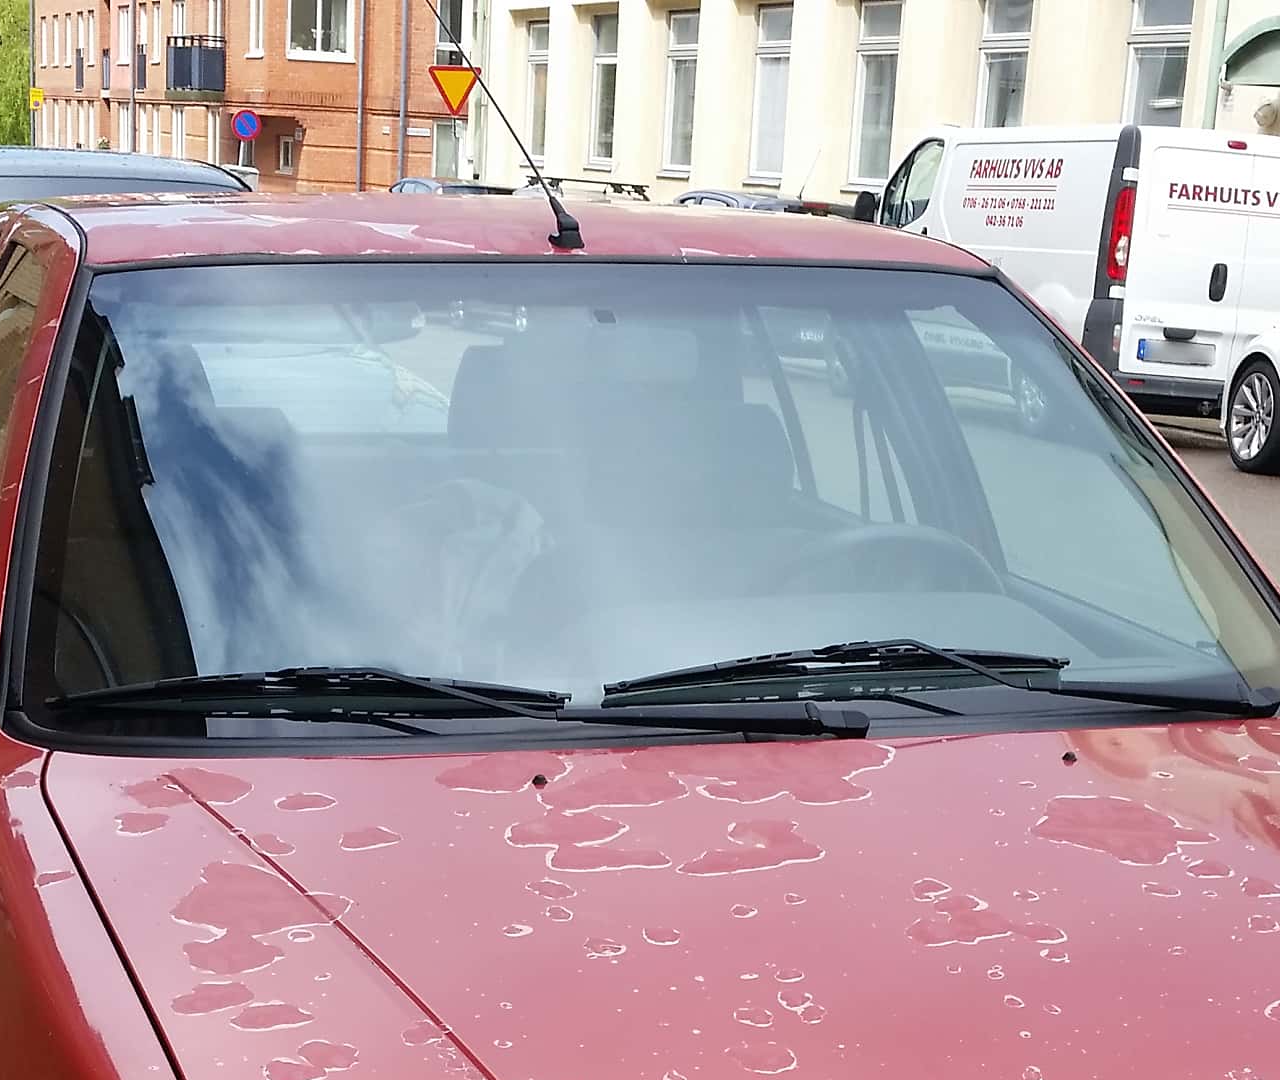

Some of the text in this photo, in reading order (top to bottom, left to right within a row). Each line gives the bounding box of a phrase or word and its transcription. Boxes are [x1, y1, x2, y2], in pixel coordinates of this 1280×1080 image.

[969, 158, 1064, 179] FARHULTS VVS AB
[1169, 182, 1261, 206] FARHULTS
